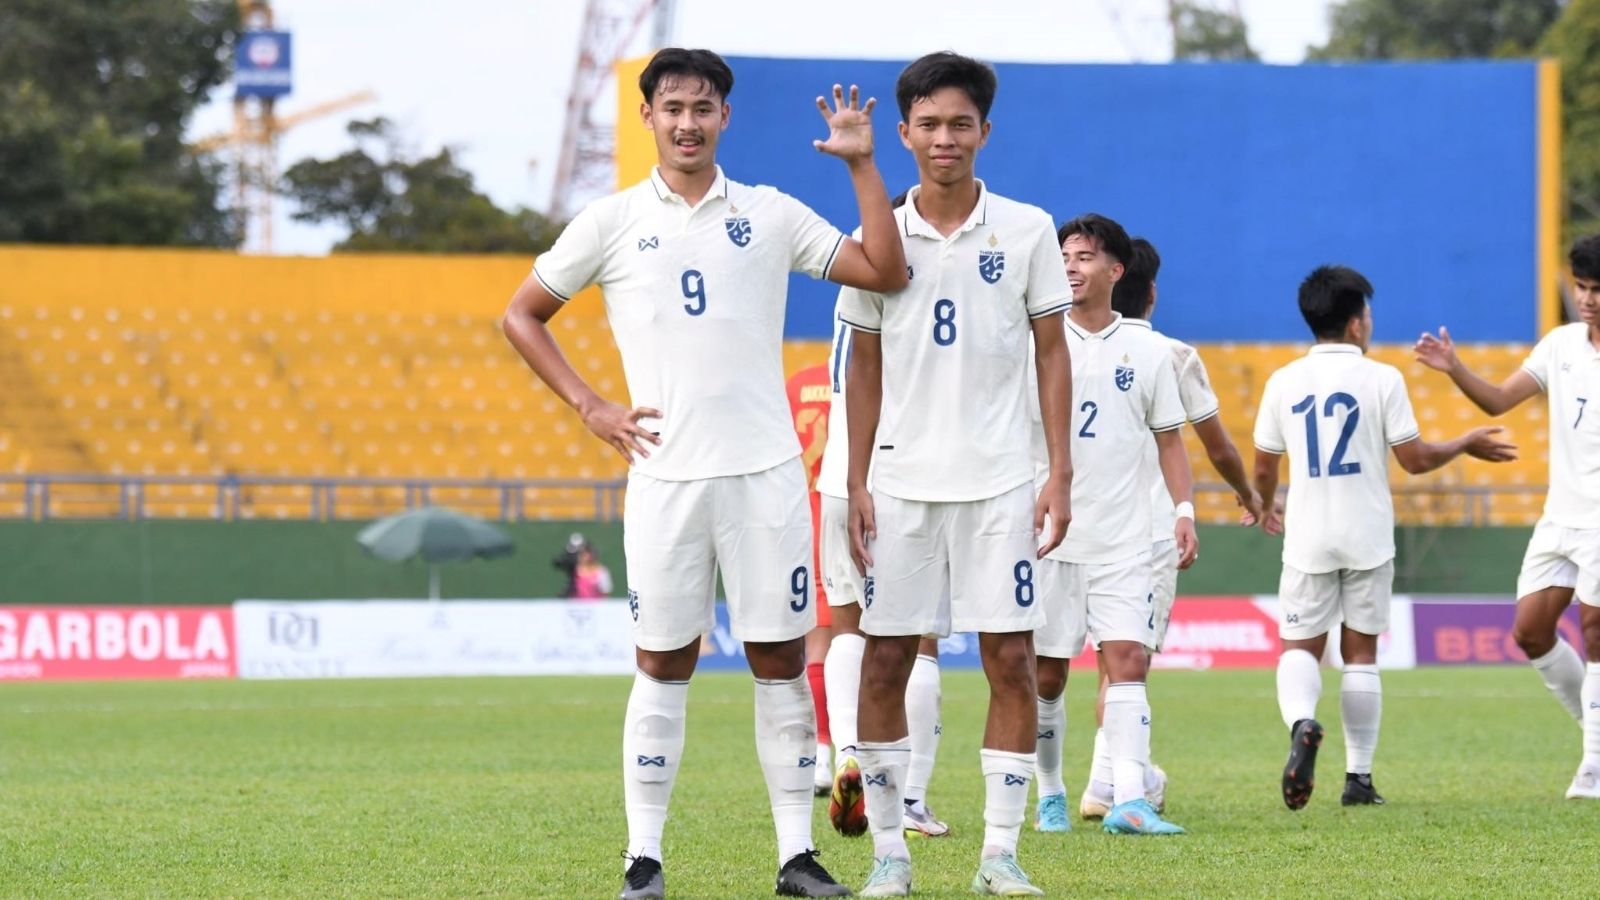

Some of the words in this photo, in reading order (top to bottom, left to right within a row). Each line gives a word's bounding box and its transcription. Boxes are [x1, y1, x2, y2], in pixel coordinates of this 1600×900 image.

[681, 269, 706, 316] 9
[933, 299, 957, 347] 8
[1079, 401, 1098, 438] 2
[1291, 391, 1361, 478] 12
[1573, 397, 1587, 430] 7
[790, 566, 808, 613] 9
[1014, 559, 1034, 607] 8
[0, 610, 229, 661] GARBOLA
